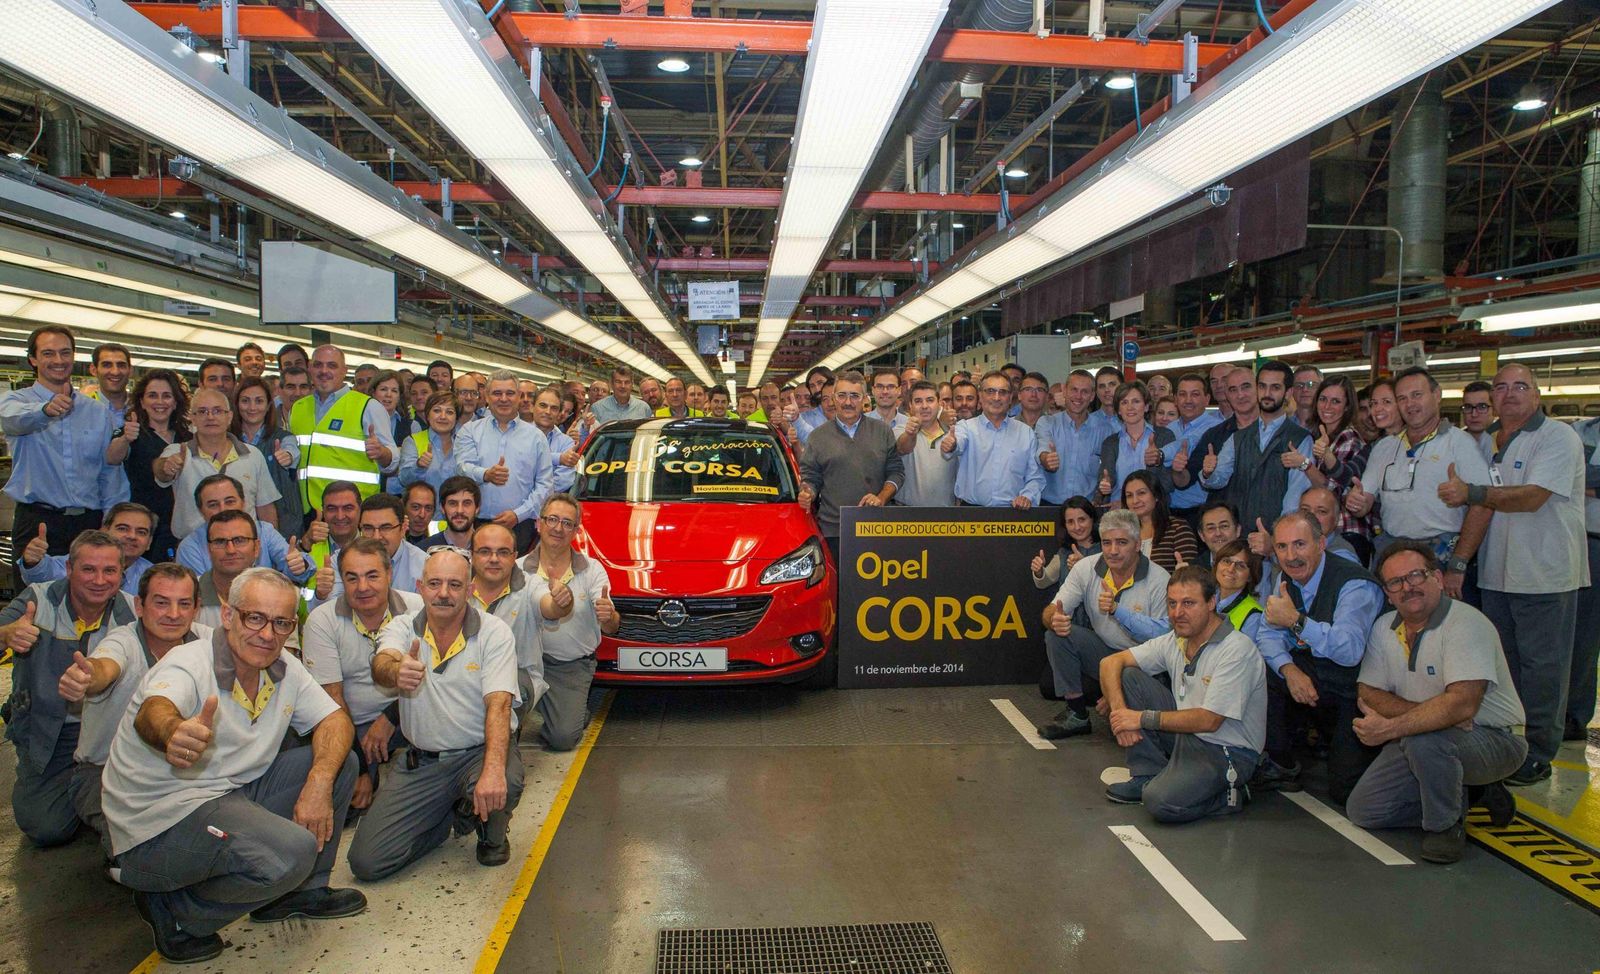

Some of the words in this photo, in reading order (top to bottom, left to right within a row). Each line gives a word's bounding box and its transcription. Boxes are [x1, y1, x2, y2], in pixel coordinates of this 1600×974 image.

[682, 439, 773, 458] generación
[585, 461, 656, 476] OPEL
[664, 461, 763, 481] CORSA
[860, 524, 894, 535] INICIO
[896, 522, 966, 535] PRODUCCIÓN
[983, 521, 1050, 535] GENERACIÓN
[856, 549, 928, 587] Opel
[856, 595, 1028, 642] CORSA
[638, 651, 708, 667] CORSA
[854, 664, 864, 675] 11
[866, 664, 879, 675] de
[880, 664, 928, 674] noviembre
[929, 663, 941, 673] de
[942, 663, 964, 673] 2014
